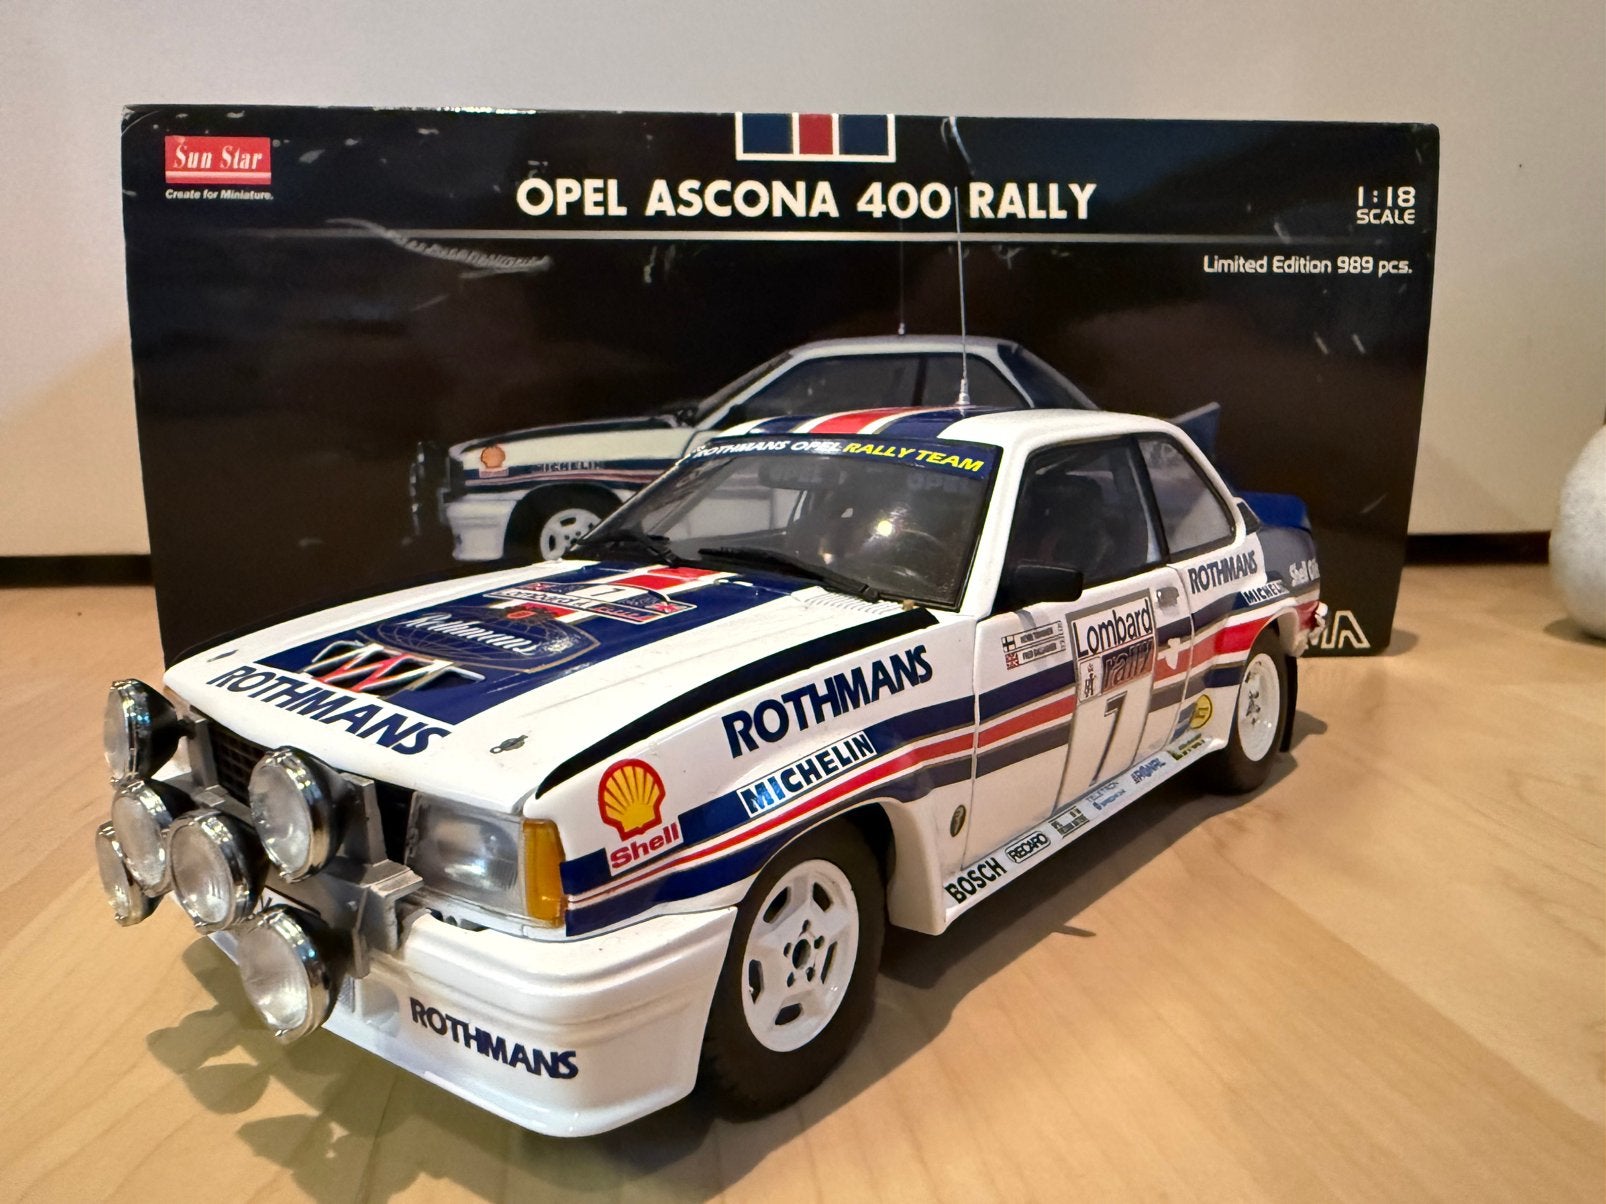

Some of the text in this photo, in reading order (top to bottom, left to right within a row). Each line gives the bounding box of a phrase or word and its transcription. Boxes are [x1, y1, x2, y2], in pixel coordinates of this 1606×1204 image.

[173, 144, 263, 170] Sun Star
[165, 189, 274, 201] Create for Miniature.
[516, 178, 1097, 220] OPEL ASCONA 400 RALLY
[1356, 208, 1416, 225] SCALE
[1357, 186, 1416, 208] 1:18
[1203, 255, 1413, 279] Limited Edition 989 pcs.
[693, 441, 985, 472] ROTHMANS OPEL RALLY TEAM
[1188, 550, 1258, 595] ROTHMANS
[399, 611, 542, 656] Rothmans
[1072, 598, 1152, 659] Lombard
[206, 665, 453, 756] ROTHMANS
[721, 644, 933, 759] ROTHMANS
[1088, 689, 1128, 787] 7
[740, 733, 875, 815] MICHELIN
[610, 821, 680, 869] Shell
[1006, 832, 1049, 862] RECARO
[944, 856, 1008, 904] BOSCH
[409, 997, 579, 1080] ROTHMANS
